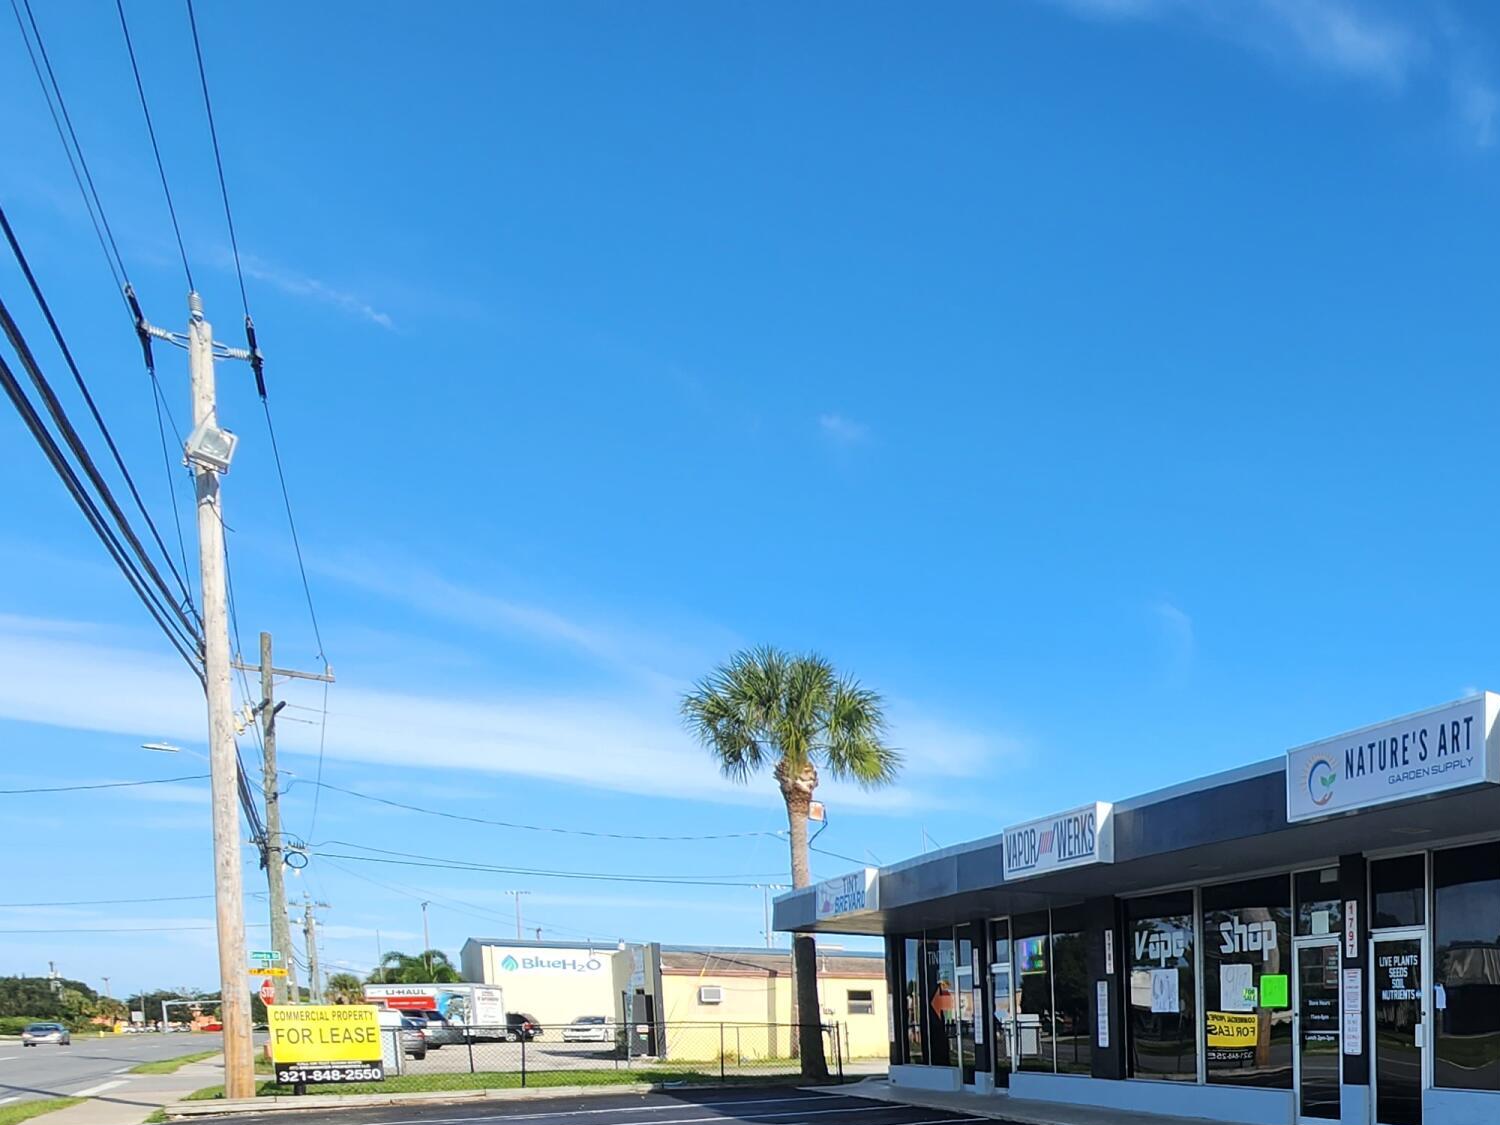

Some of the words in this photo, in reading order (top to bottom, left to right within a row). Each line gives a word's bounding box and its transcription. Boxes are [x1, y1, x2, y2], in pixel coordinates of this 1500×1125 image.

[1345, 729, 1428, 780] NATURE'S
[1438, 716, 1474, 757] ART
[1388, 768, 1430, 785] GARDEN
[1431, 756, 1475, 775] SUPPLY
[1007, 828, 1038, 869] VAPOR
[1055, 812, 1095, 859] WERKS
[842, 874, 859, 895] TINT
[834, 890, 866, 913] BREVARD
[1348, 902, 1356, 956] 1797
[1379, 956, 1393, 967] LIVE
[1393, 955, 1418, 966] PLANTS
[1389, 967, 1408, 978] SEEDS
[1391, 978, 1405, 989] SOIL
[386, 988, 427, 996] U-HAUL
[1382, 989, 1416, 1000] NUTRIENTS
[274, 1011, 330, 1021] COMMERCIAL
[332, 1010, 373, 1021] PROPERTY
[275, 1028, 314, 1045] FOR
[319, 1027, 377, 1044] LEASE
[279, 1069, 381, 1082] 321-848-2550
